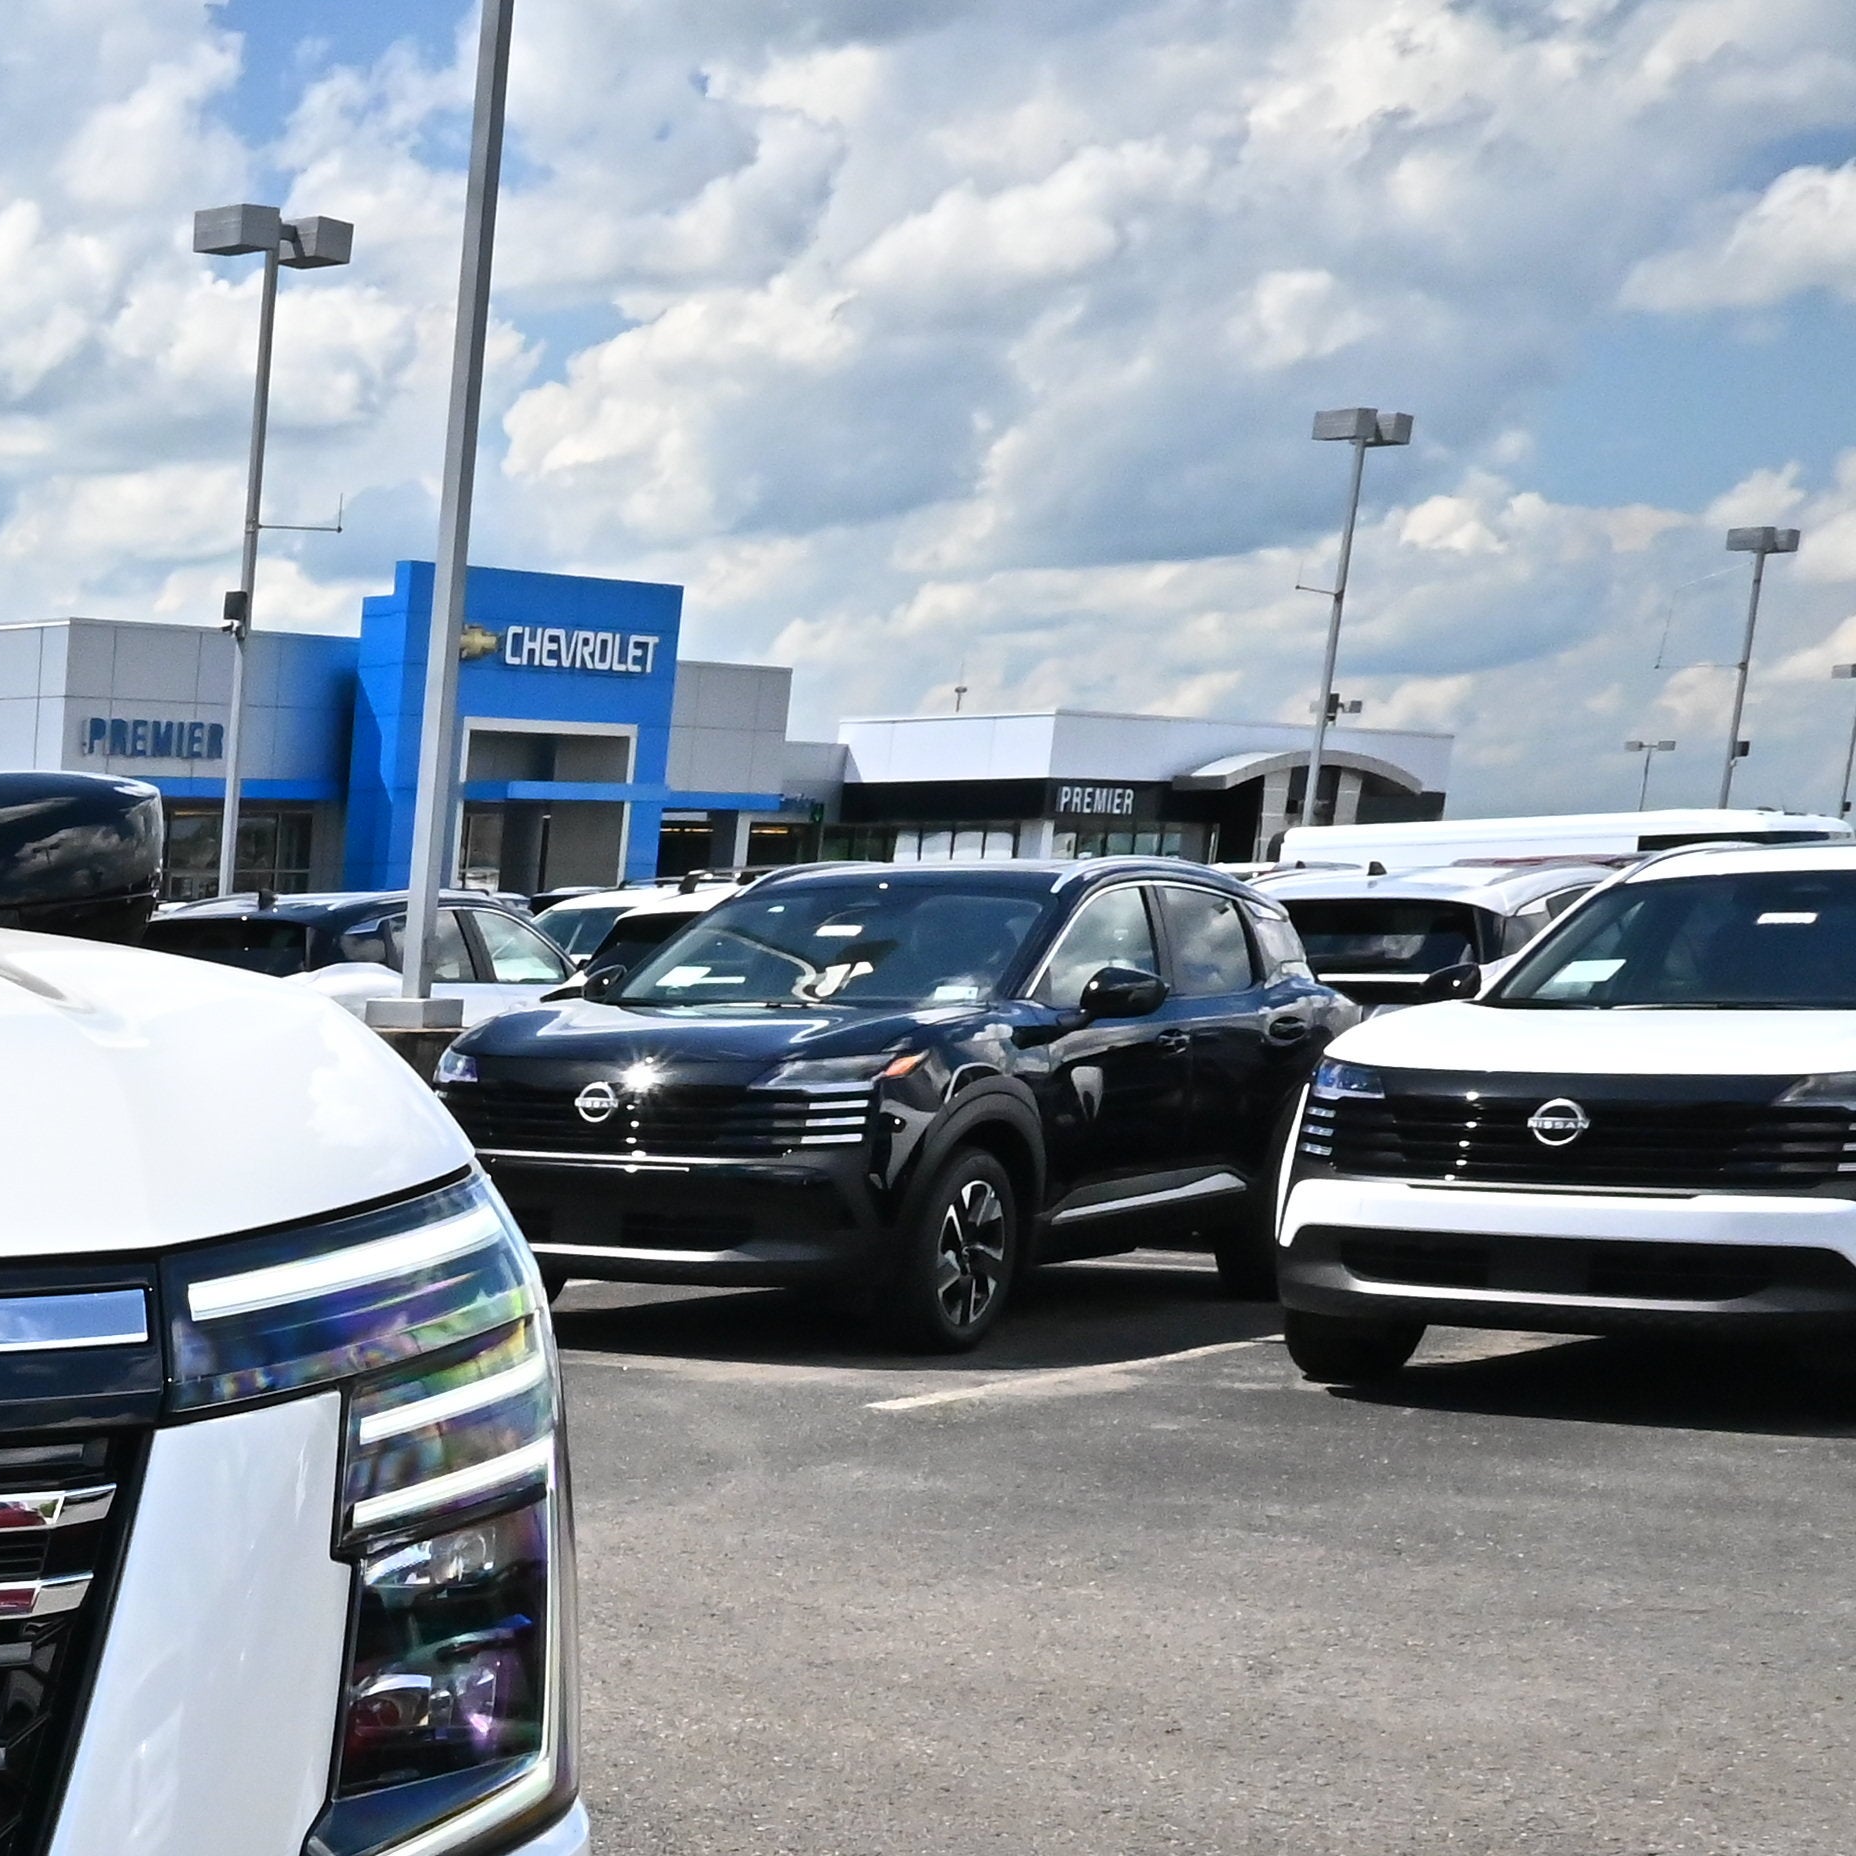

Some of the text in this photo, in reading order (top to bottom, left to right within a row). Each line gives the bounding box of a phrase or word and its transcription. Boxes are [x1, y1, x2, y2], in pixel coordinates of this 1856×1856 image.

[504, 624, 660, 674] CHEVROLET
[87, 716, 225, 760] PREMIER
[1058, 785, 1135, 815] PREMIER
[1526, 1118, 1591, 1130] NISSAN
